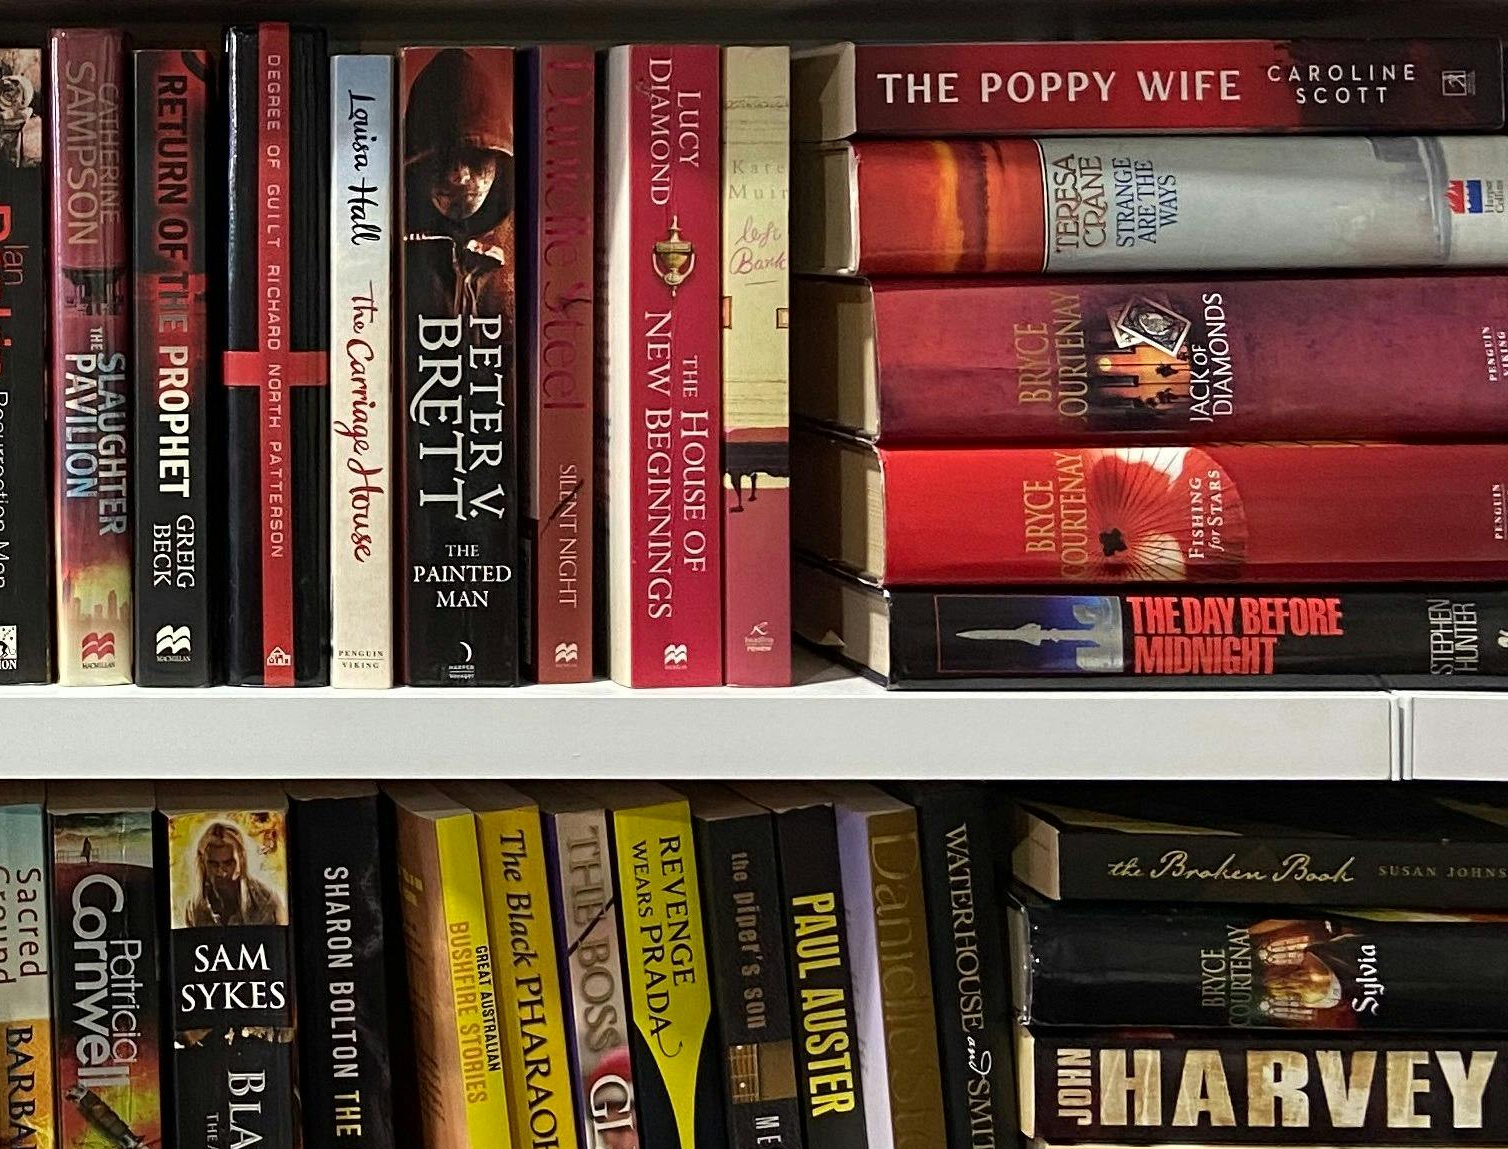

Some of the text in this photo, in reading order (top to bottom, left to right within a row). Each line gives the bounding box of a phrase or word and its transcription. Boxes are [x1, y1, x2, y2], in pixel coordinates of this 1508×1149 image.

[877, 69, 1242, 103] THE POPPY WIFE
[1267, 63, 1417, 82] CAROLINE
[1296, 85, 1390, 104] SCOTT
[346, 89, 381, 247] Louisa Hall
[647, 57, 672, 207] DIAMOND
[677, 90, 701, 168] LUCY
[158, 75, 190, 498] RETURN PROPHET
[64, 354, 98, 499] PAVILION
[409, 314, 468, 522] BRETT
[469, 314, 503, 472] PETER
[97, 353, 128, 537] SLAUGHTER
[681, 410, 708, 521] HOUSE
[269, 442, 284, 559] PATTERSON
[645, 408, 674, 620] BEGINNINGS
[153, 523, 172, 588] BECK
[175, 514, 195, 589] GREIG
[414, 566, 512, 583] PAINTED
[436, 591, 489, 608] MAN
[1126, 598, 1344, 637] THE DAY BEFORE
[1133, 637, 1279, 676] MIDNIGHT
[16, 868, 48, 977] Sacred
[194, 943, 271, 973] SAM
[181, 981, 286, 1012] SYKES
[324, 867, 358, 1078] SHARON BOLTON
[792, 892, 859, 1118] PAUL AUSTER
[1057, 1048, 1498, 1129] JOHN HARVEY
